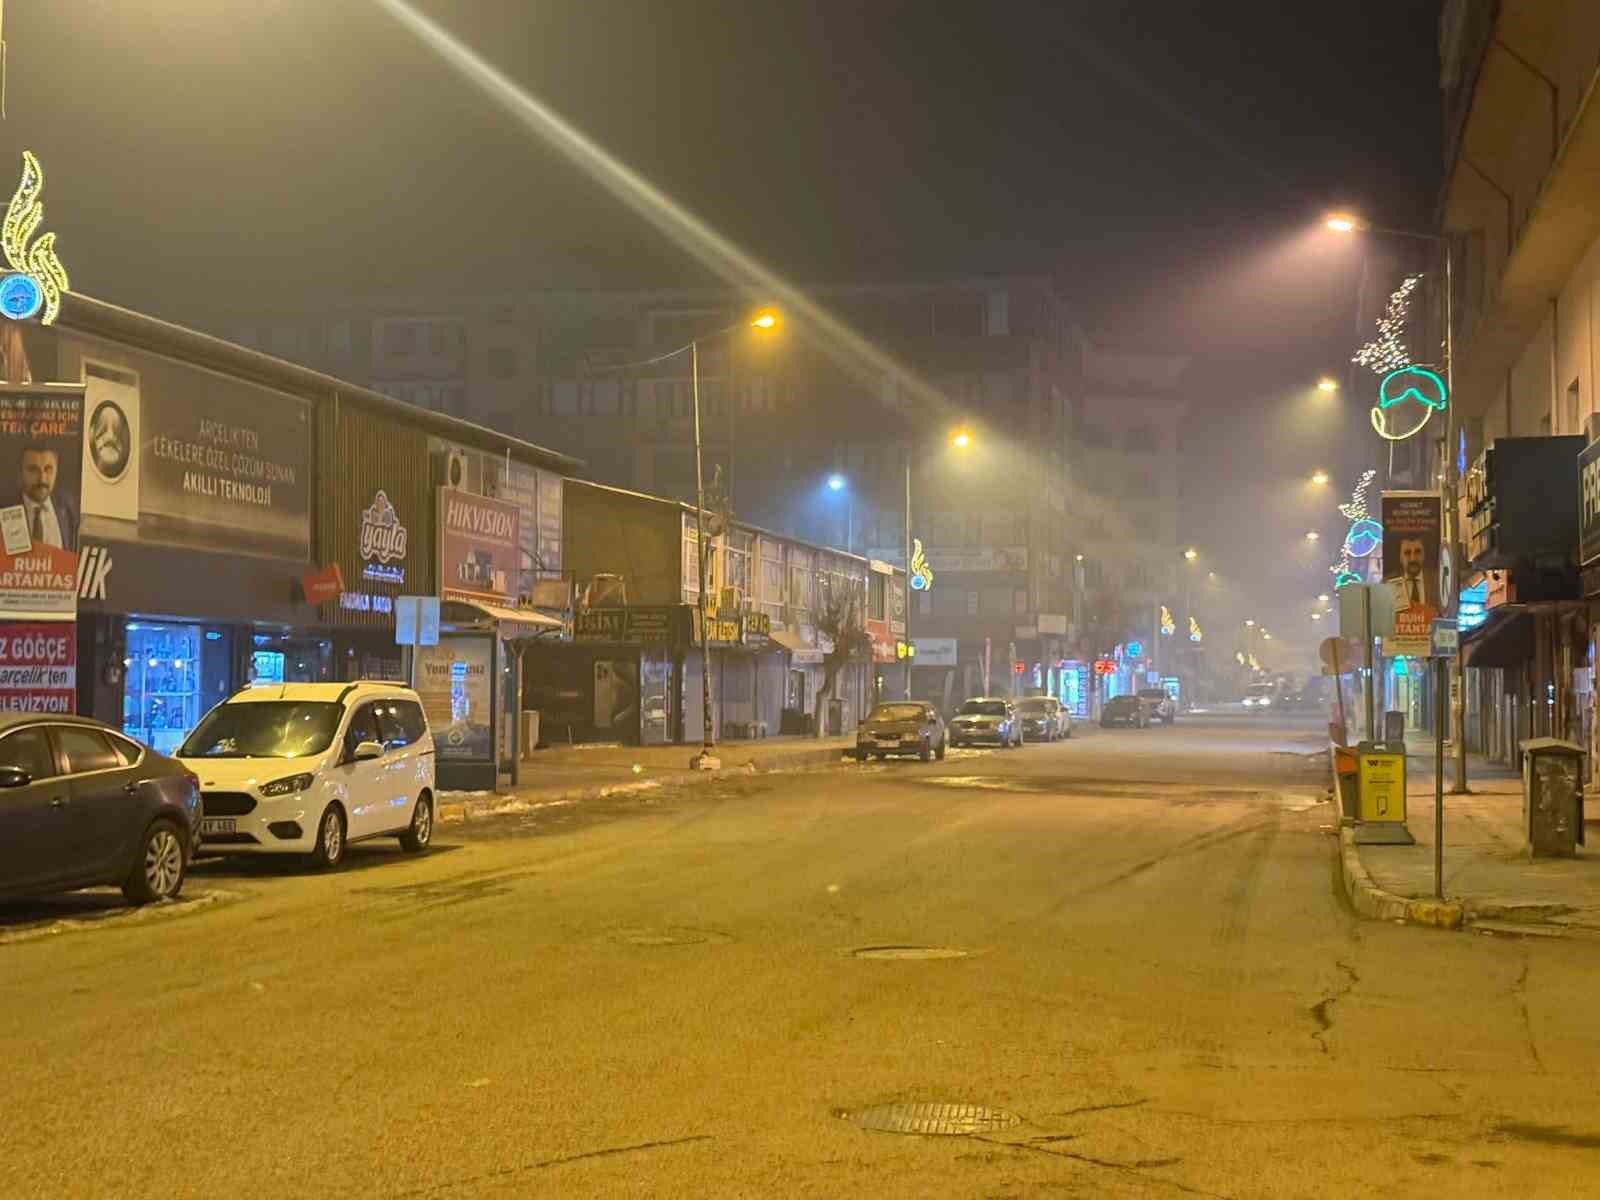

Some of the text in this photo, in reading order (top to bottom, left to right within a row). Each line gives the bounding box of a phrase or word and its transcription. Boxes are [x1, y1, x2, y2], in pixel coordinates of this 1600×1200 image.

[183, 471, 272, 507] AKILLI TEKNOLOJİ
[447, 498, 513, 537] HIKVISION
[363, 523, 405, 557] yayla
[0, 691, 69, 712] LEVİZYON
